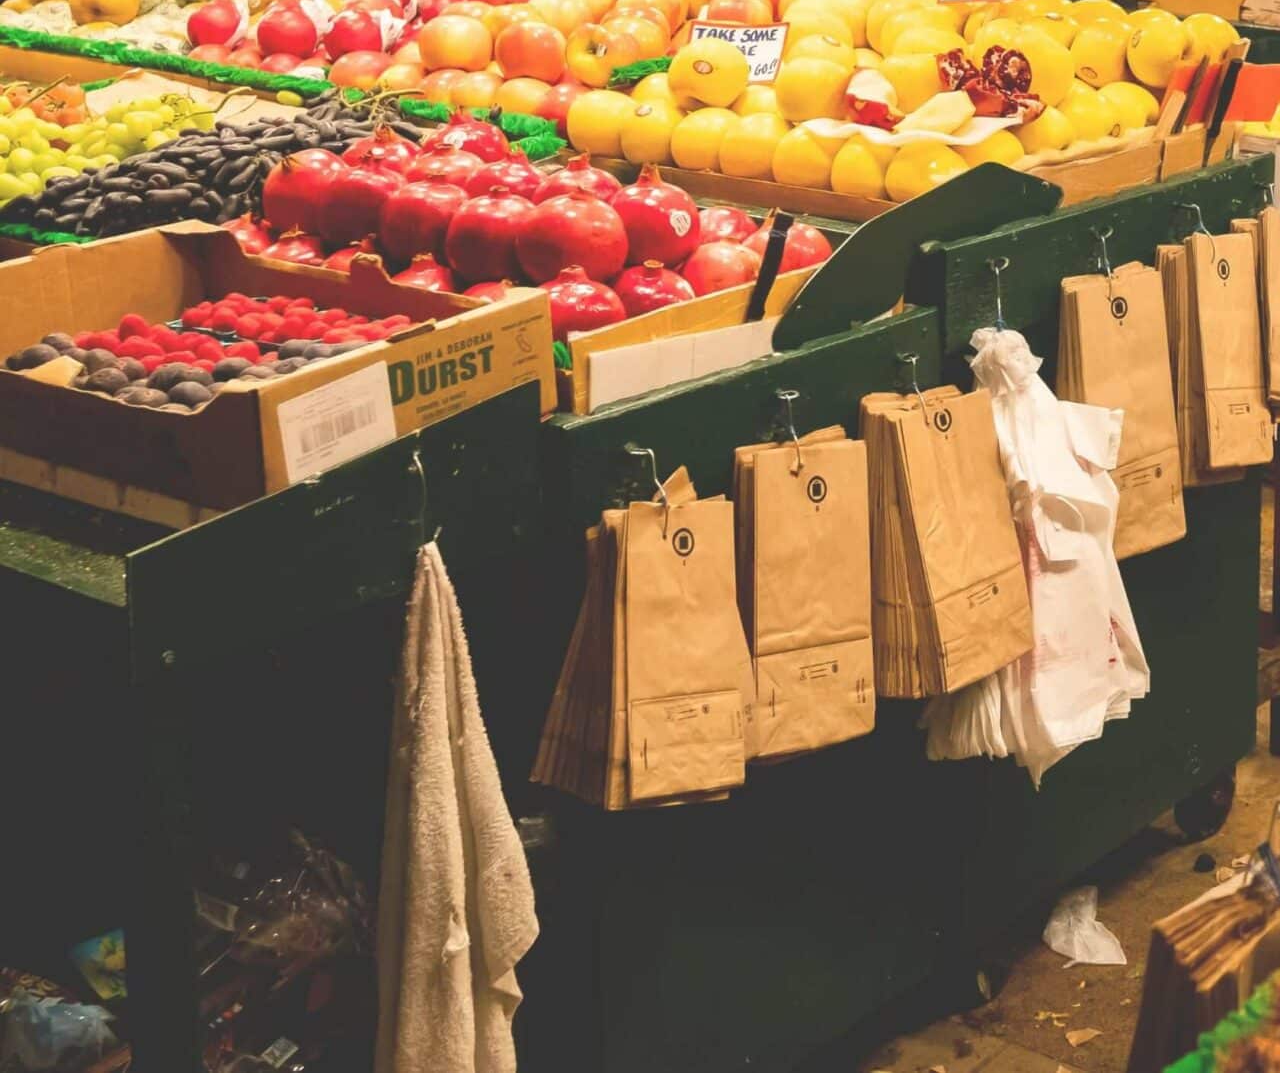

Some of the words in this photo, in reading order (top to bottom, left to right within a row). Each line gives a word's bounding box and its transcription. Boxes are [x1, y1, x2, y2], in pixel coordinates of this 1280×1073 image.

[695, 27, 737, 41] TAKE
[740, 28, 778, 43] SOME
[416, 350, 435, 367] JIM
[437, 348, 445, 360] &
[447, 331, 493, 357] DEBORAH
[388, 343, 495, 407] DURST
